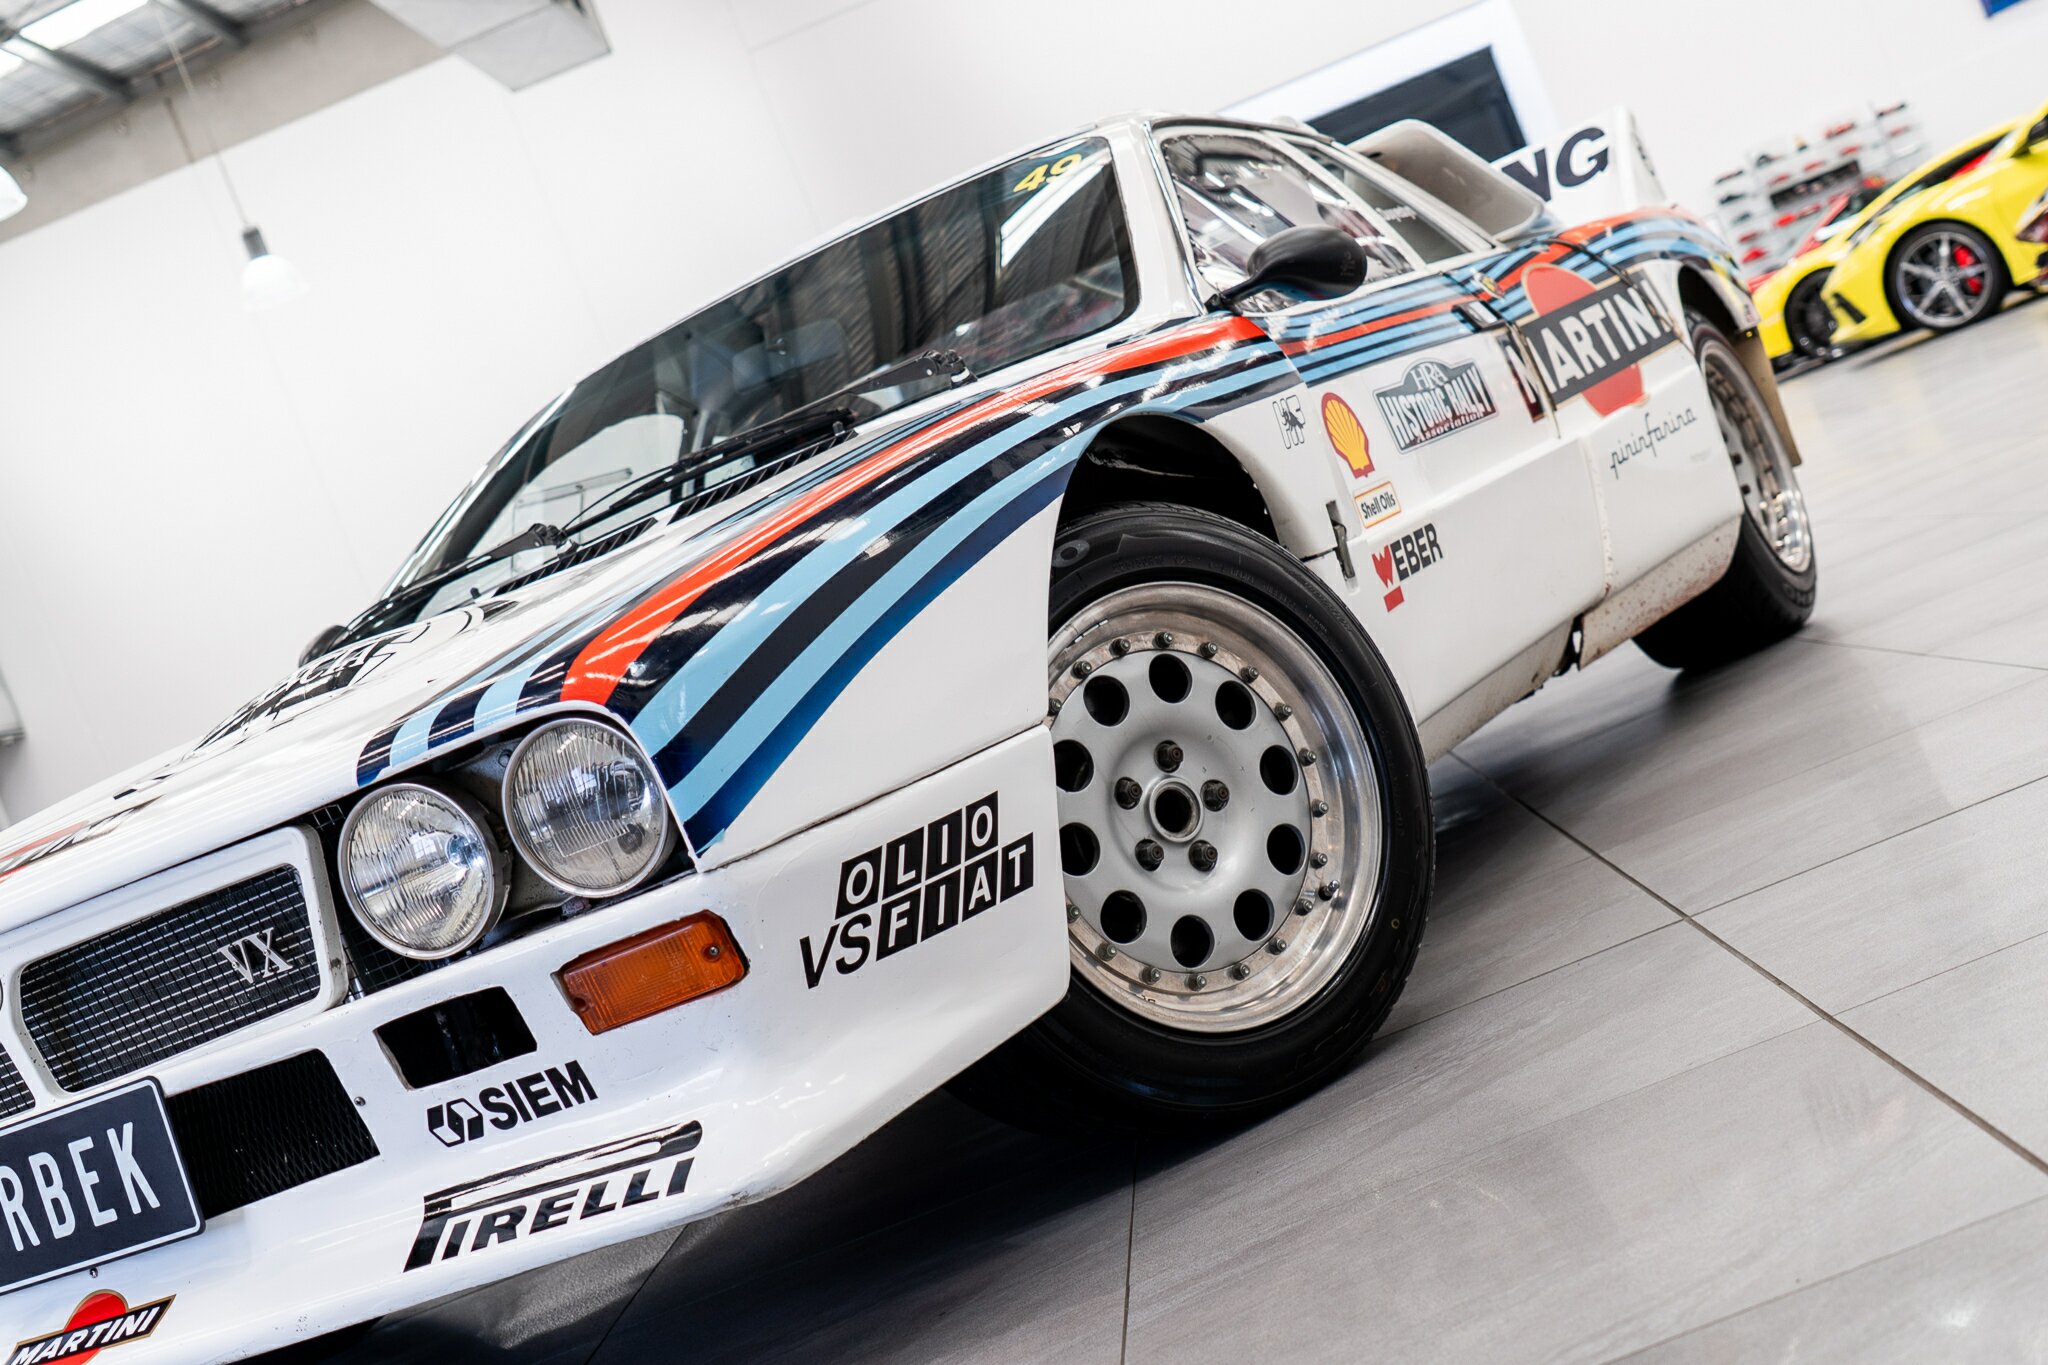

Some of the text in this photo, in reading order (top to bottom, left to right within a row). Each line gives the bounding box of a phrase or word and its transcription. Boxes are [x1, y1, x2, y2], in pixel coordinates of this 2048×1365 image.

[1012, 153, 1082, 193] 49
[1410, 362, 1449, 391] HRA
[1505, 279, 1672, 404] MARTINI
[1379, 366, 1493, 448] HISTORIC RALLY
[1610, 407, 1697, 480] pininfarina
[1361, 492, 1396, 519] Shell Oils
[1371, 522, 1444, 588] WEBER
[845, 804, 994, 905] OLIO
[217, 927, 293, 984] VX
[478, 1060, 598, 1130] SIEM
[0, 1122, 160, 1252] RBEK
[403, 1120, 703, 1273] PIRELLI
[10, 1306, 160, 1365] MARTINI
